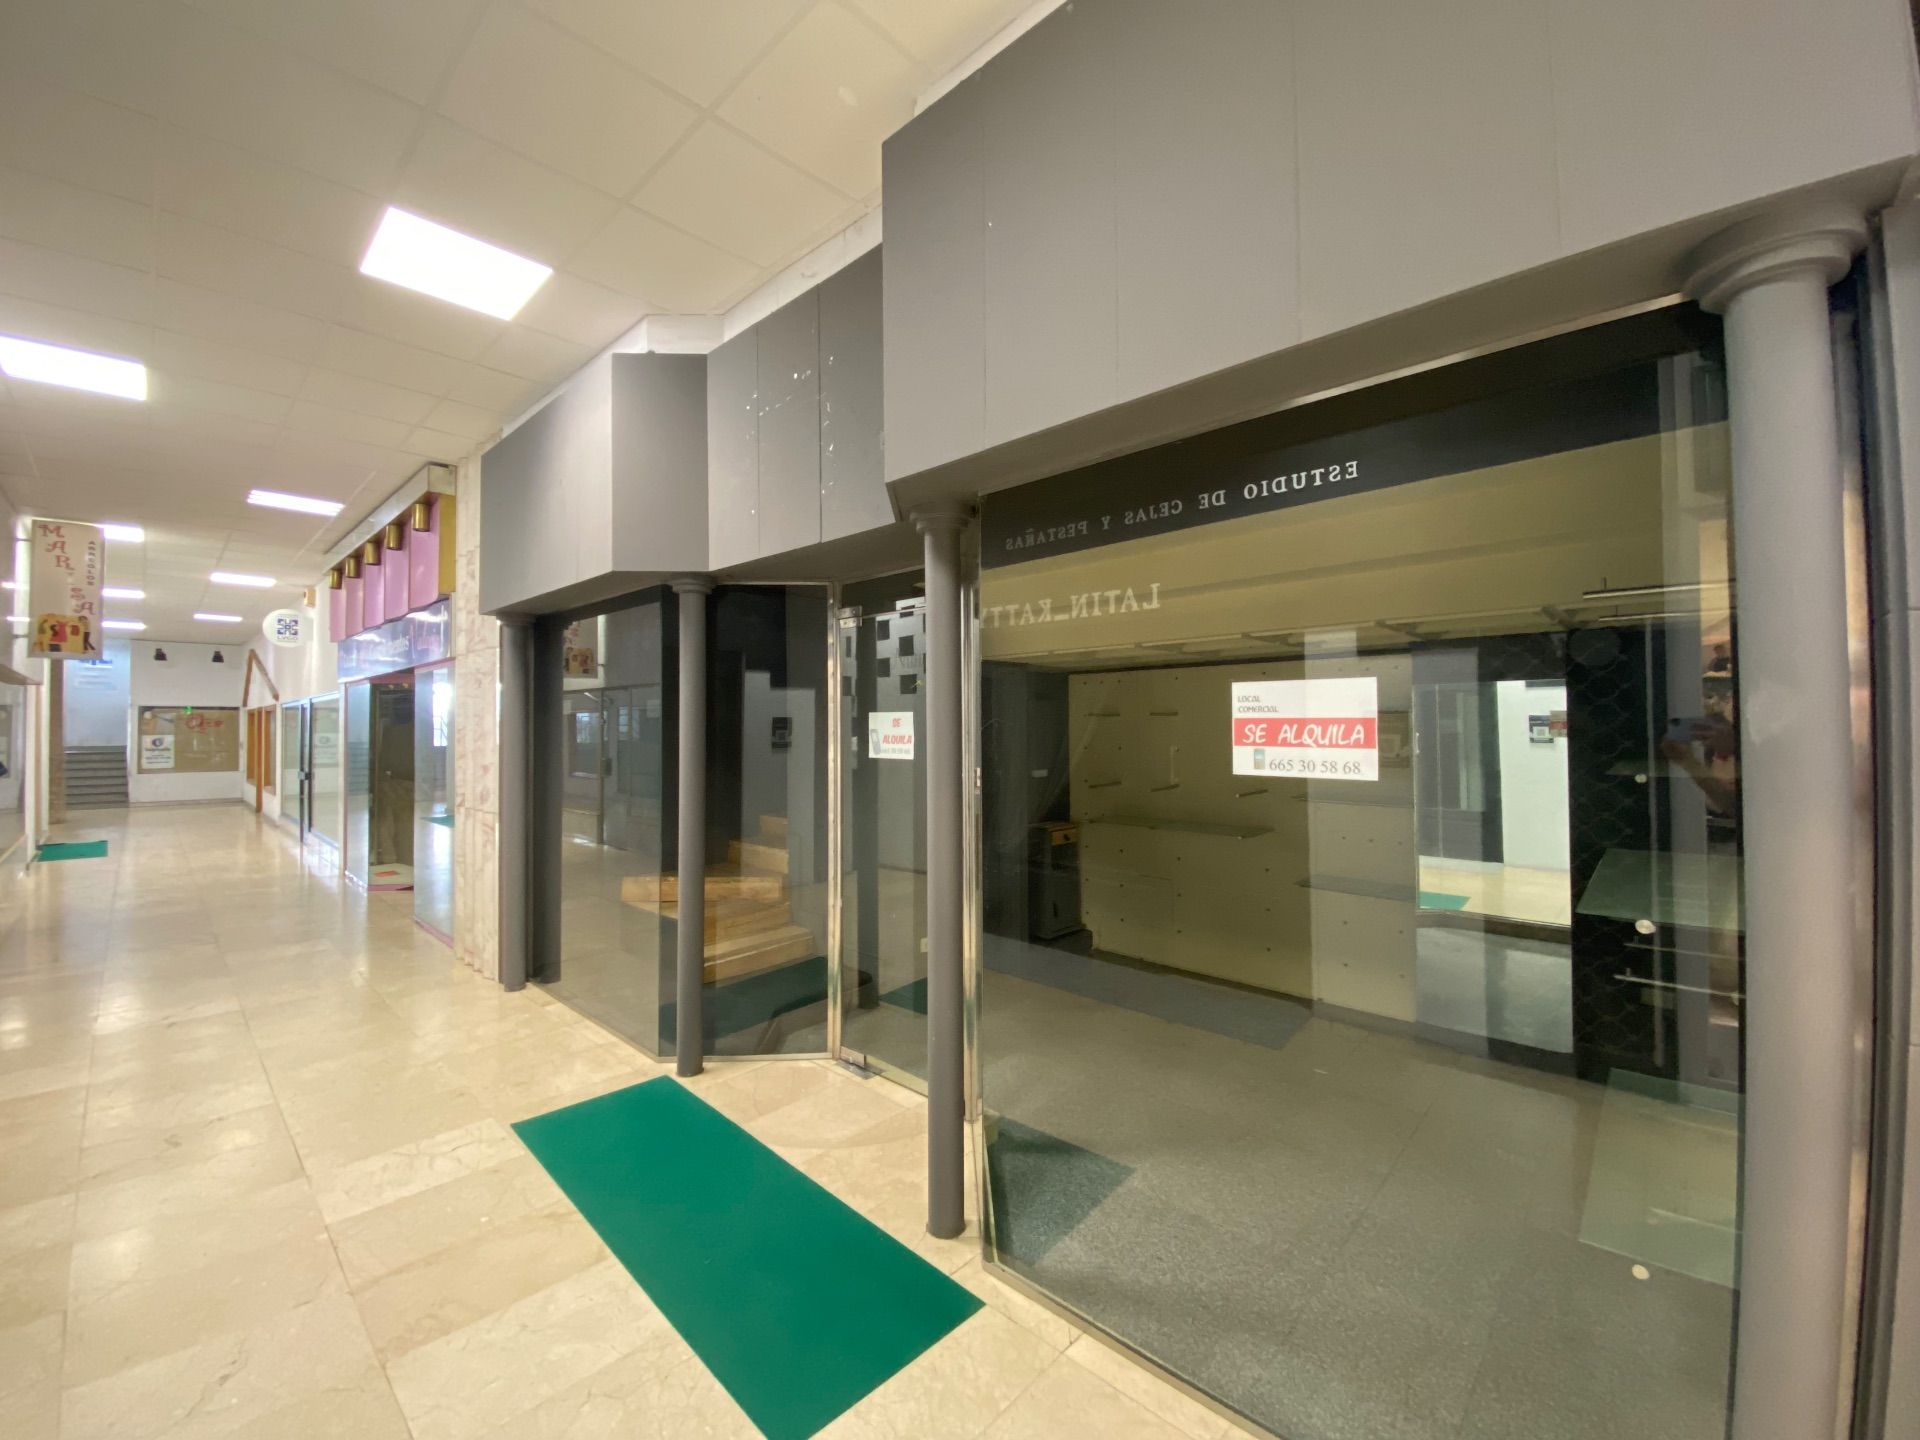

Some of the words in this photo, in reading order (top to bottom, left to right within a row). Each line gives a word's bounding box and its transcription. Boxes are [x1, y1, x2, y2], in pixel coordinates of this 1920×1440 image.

[38, 524, 96, 615] MARSA
[1238, 695, 1260, 703] LOCAL
[1238, 705, 1279, 713] COMERCIAL
[882, 734, 912, 745] ALQUILA
[1243, 723, 1267, 744] SE
[1277, 723, 1365, 748] ALQUILA
[1269, 759, 1294, 772] 665
[1297, 760, 1316, 772] 30
[1320, 761, 1338, 774] 58
[1343, 762, 1361, 774] 68
